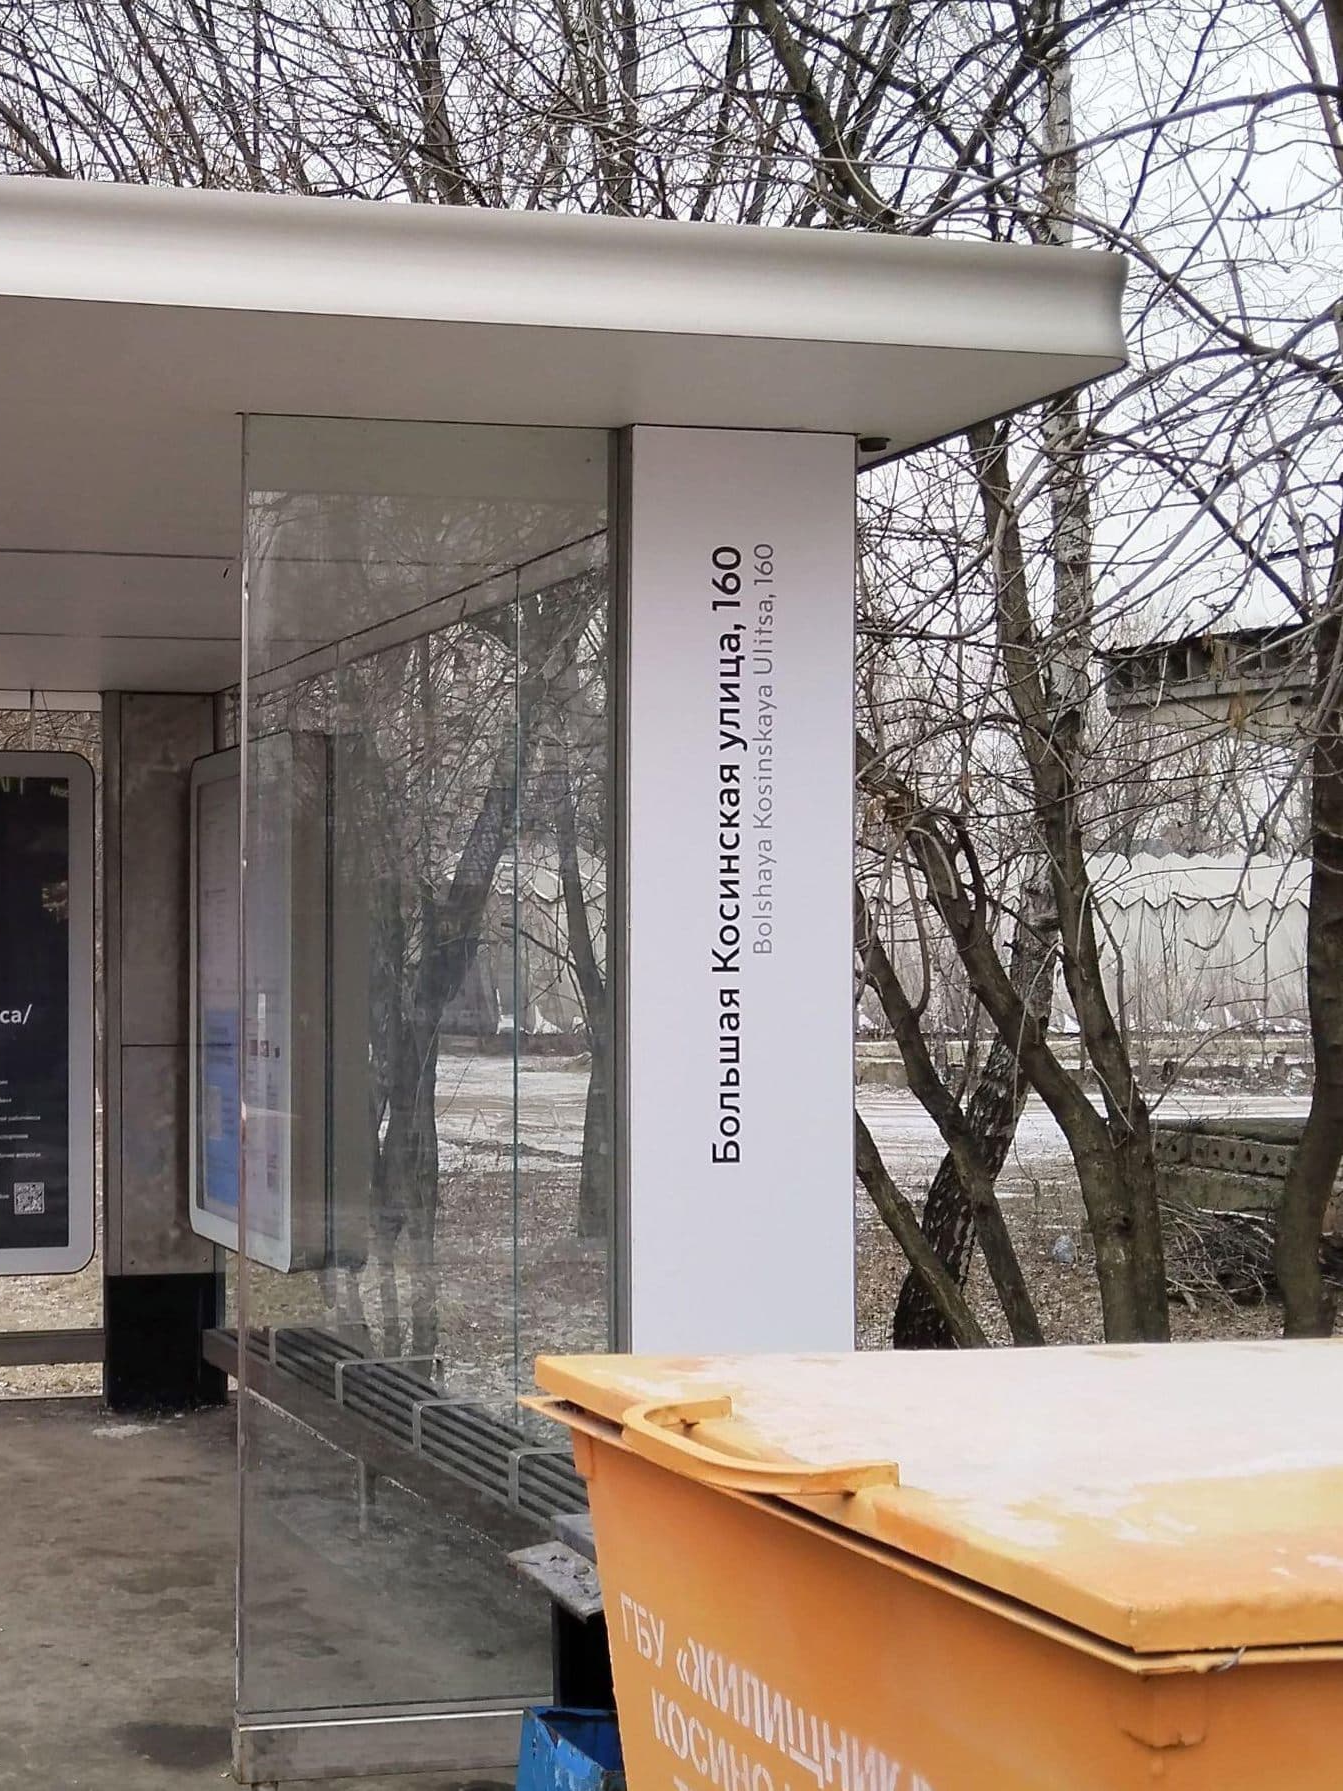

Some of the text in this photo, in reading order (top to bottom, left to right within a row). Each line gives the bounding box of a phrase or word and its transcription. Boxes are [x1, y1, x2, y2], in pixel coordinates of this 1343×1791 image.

[711, 546, 748, 1164] Большая Косинская улица, 160
[752, 543, 778, 955] Bolshaya Kosinskaya Ulitsa, 160
[620, 1591, 665, 1668] ГБУ
[651, 1687, 791, 1791] КОСИНО
